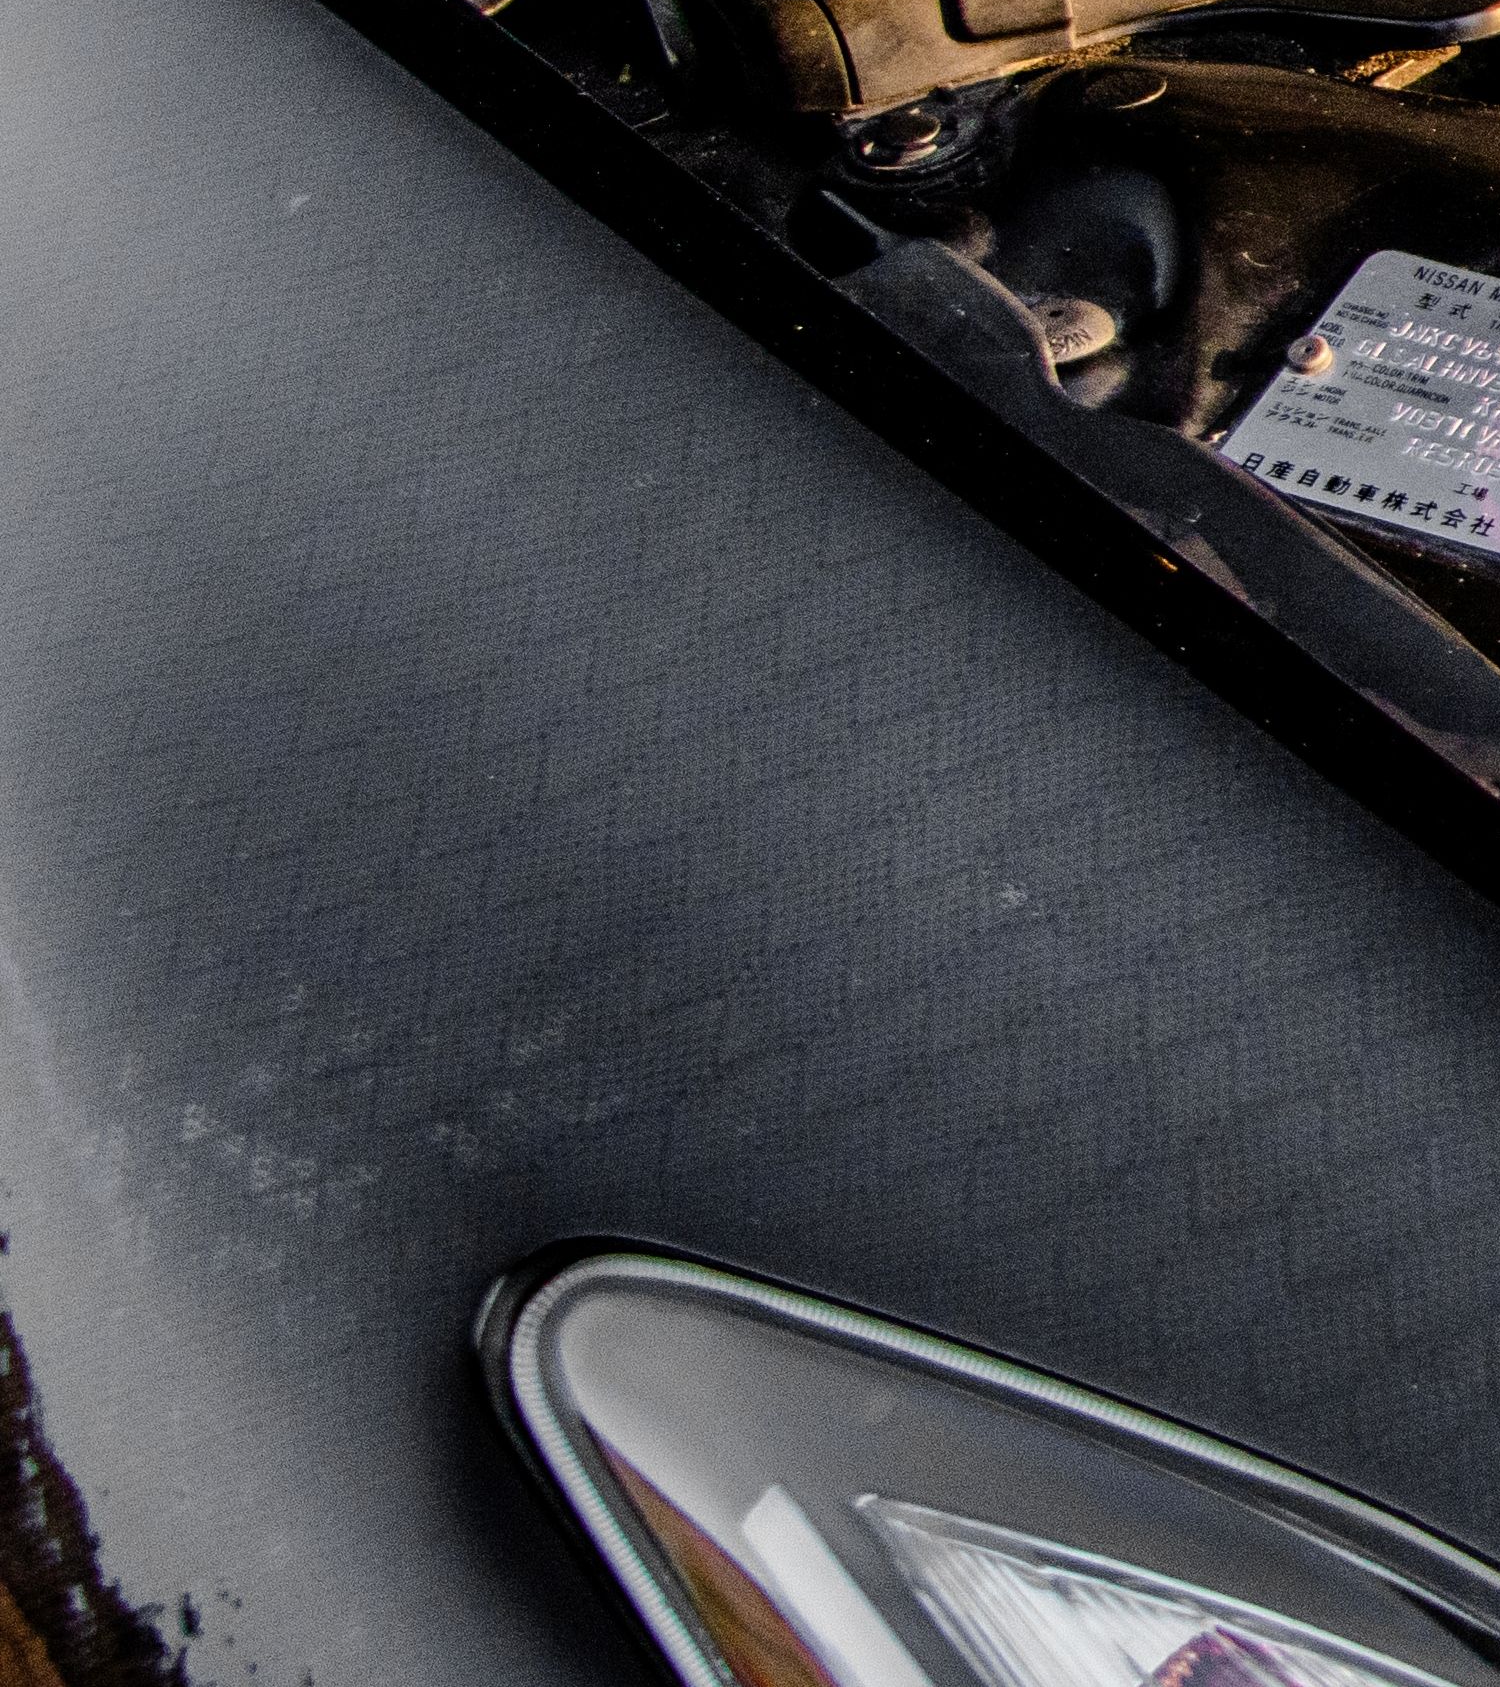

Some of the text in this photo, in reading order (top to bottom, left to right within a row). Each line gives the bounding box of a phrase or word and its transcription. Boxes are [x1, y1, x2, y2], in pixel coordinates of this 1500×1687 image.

[1410, 265, 1486, 296] NISSAN
[1239, 444, 1499, 544] 日産自動車株式会社
